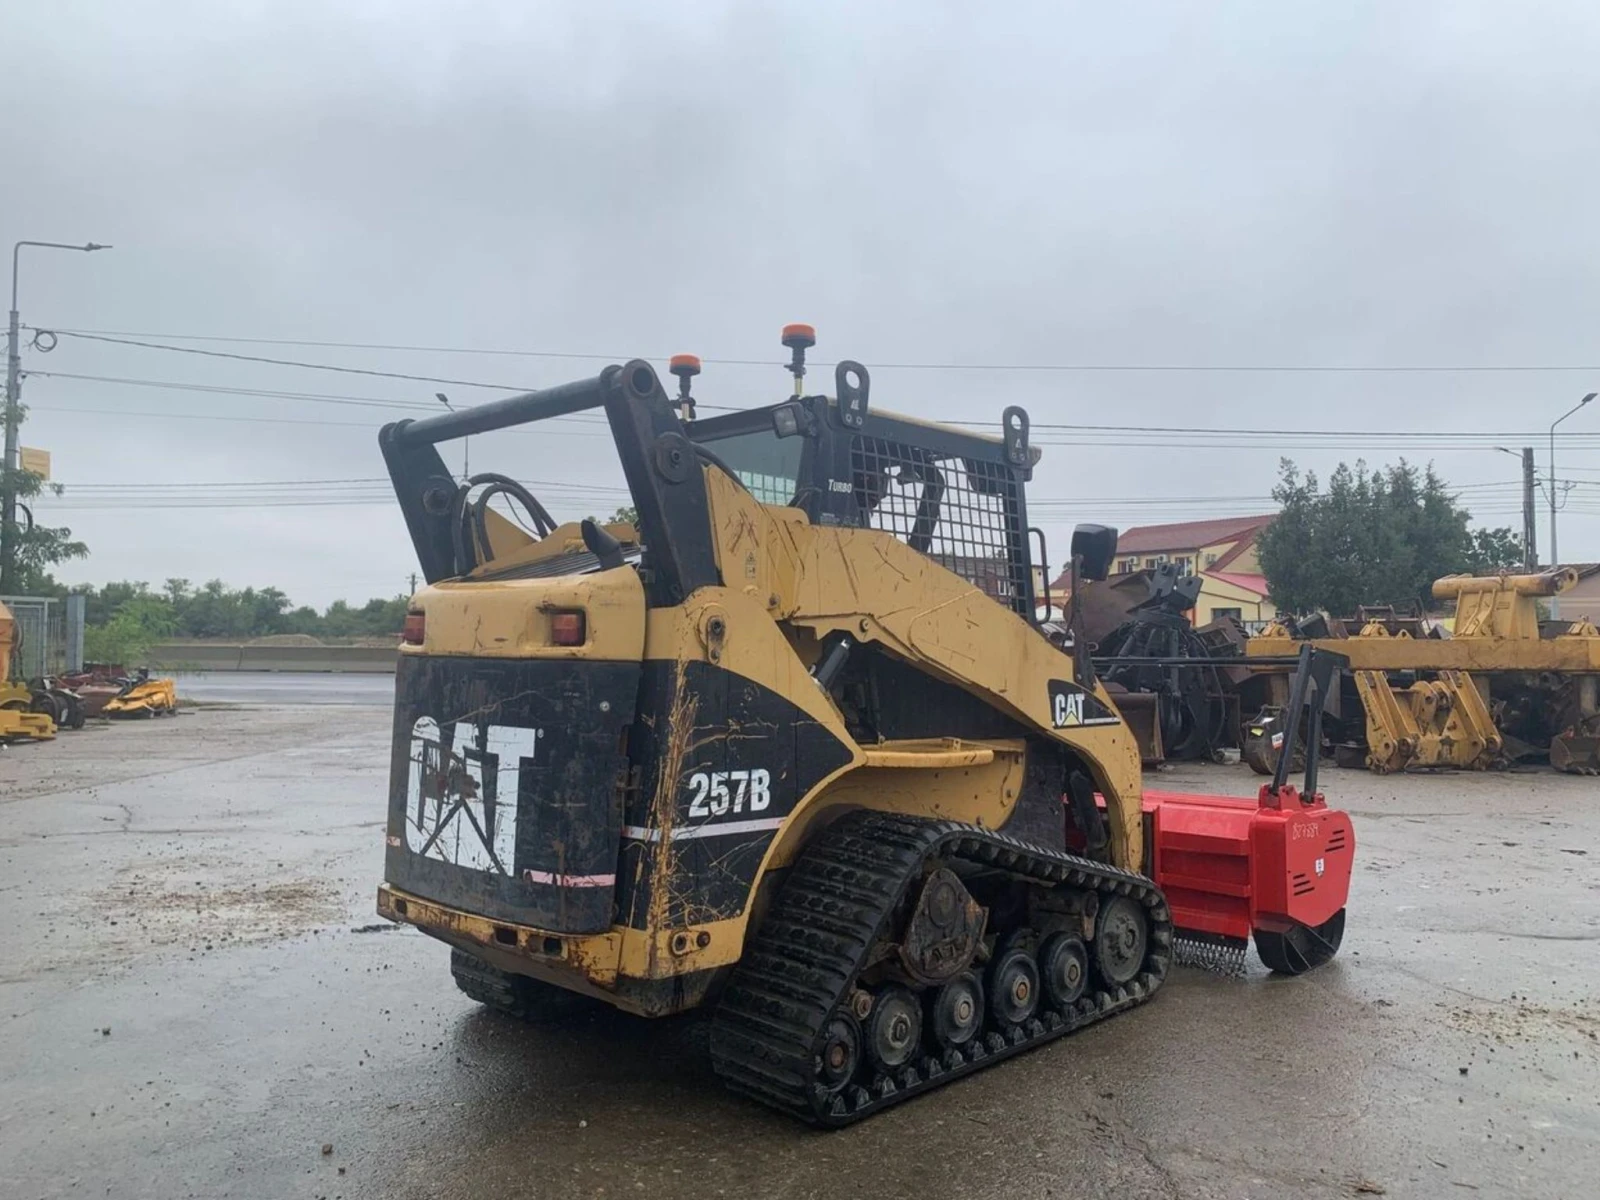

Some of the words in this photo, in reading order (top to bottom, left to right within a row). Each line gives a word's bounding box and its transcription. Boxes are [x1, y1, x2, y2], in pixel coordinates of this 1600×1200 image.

[1055, 693, 1085, 727] CAT
[405, 715, 536, 877] CAT
[688, 768, 771, 817] 257B
